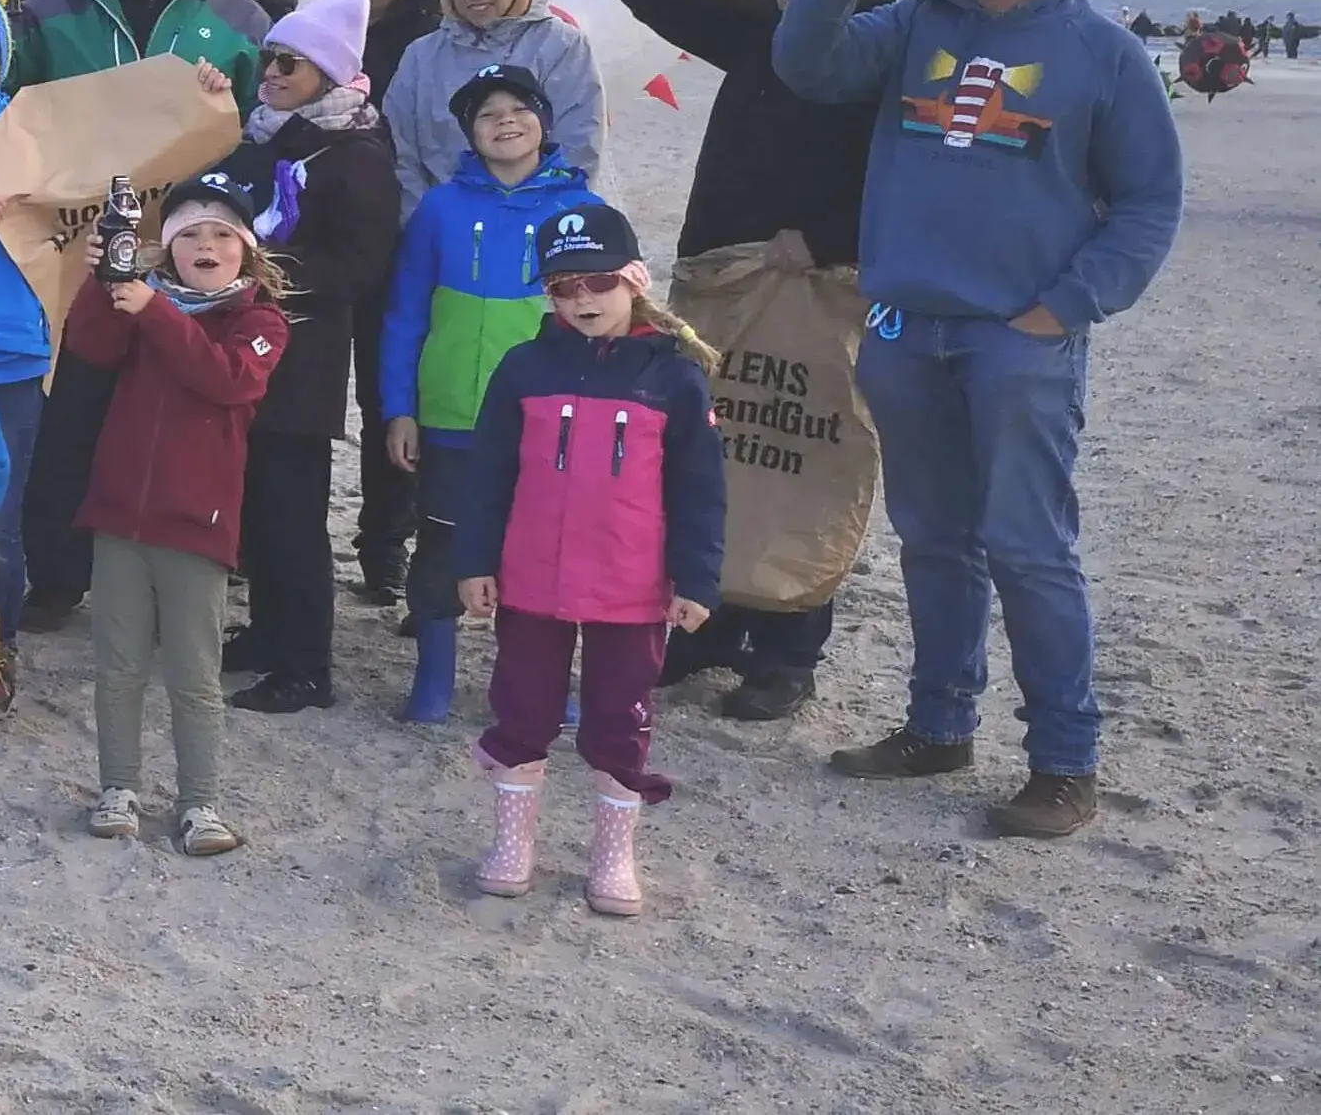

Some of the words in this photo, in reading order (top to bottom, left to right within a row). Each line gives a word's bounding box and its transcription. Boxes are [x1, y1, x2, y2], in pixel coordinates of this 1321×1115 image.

[718, 350, 809, 397] LENS
[713, 395, 842, 445] andGut
[723, 433, 804, 475] tion
